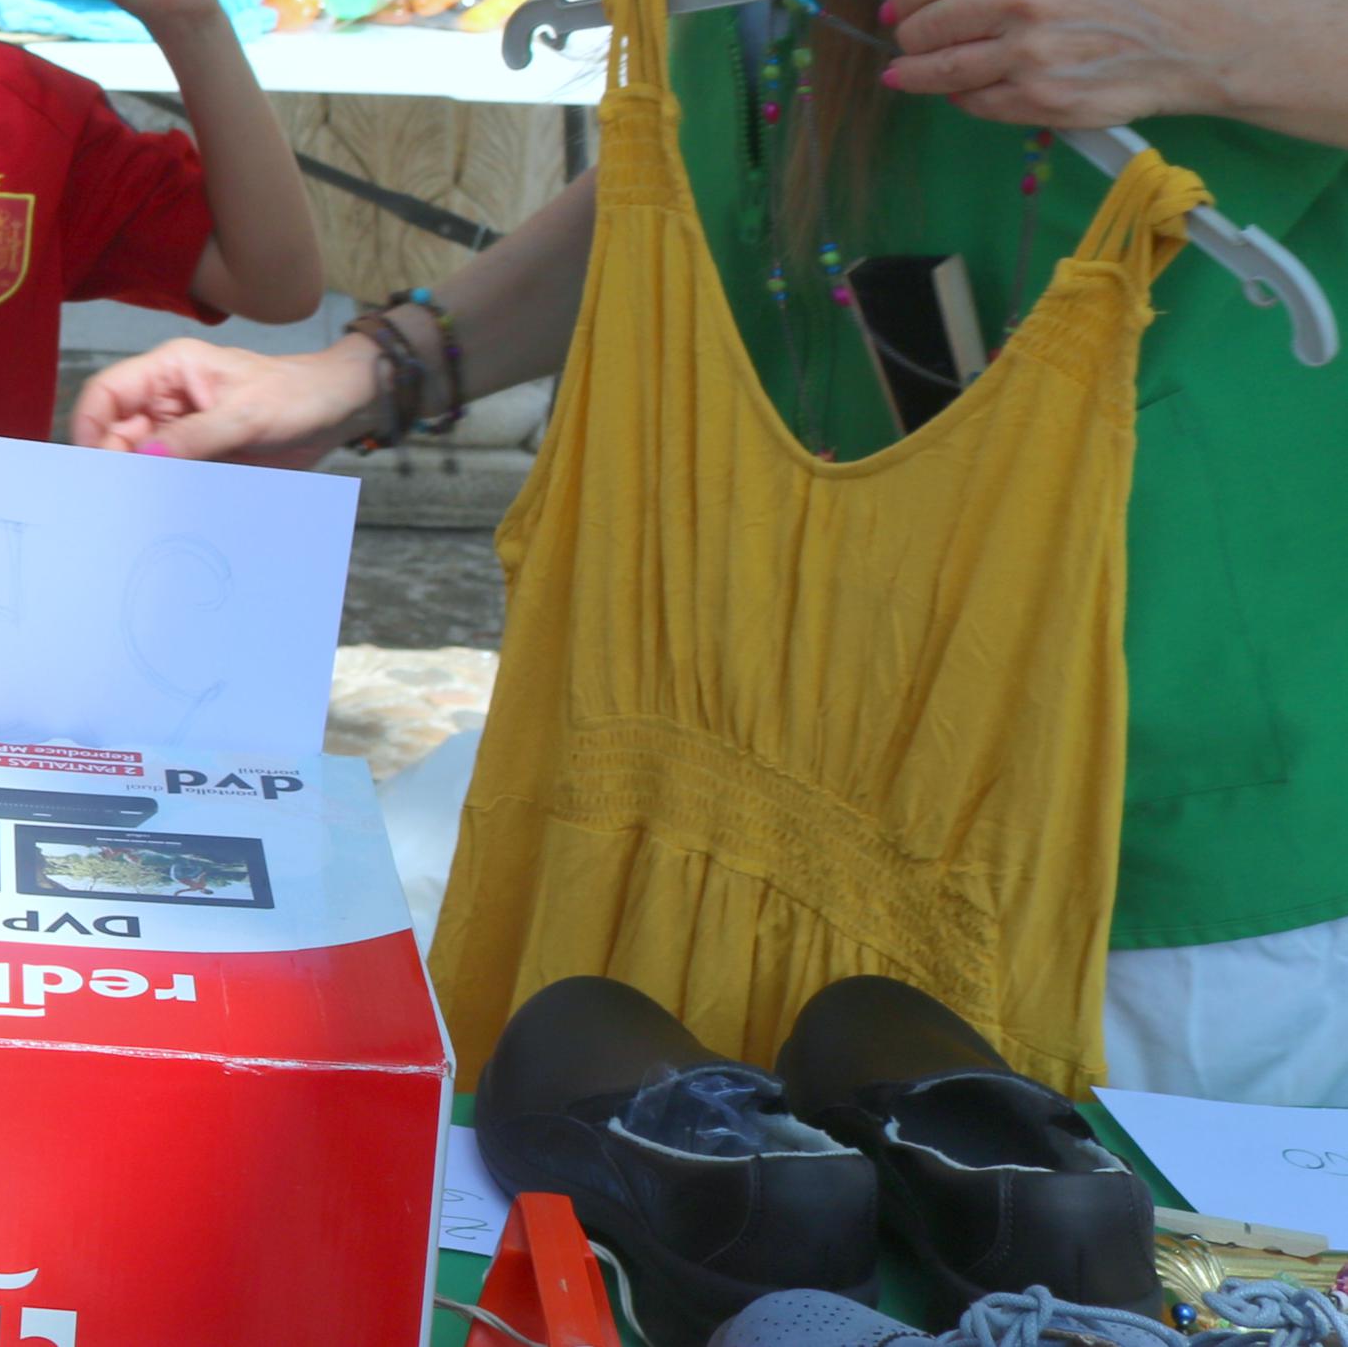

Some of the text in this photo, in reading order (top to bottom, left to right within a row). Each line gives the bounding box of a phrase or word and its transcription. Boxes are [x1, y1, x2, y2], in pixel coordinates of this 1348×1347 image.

[34, 744, 136, 763] Reproduce
[9, 758, 118, 773] PANTALLAS
[124, 766, 137, 775] 2
[126, 783, 258, 797] pantalla dual
[164, 768, 304, 800] dvd
